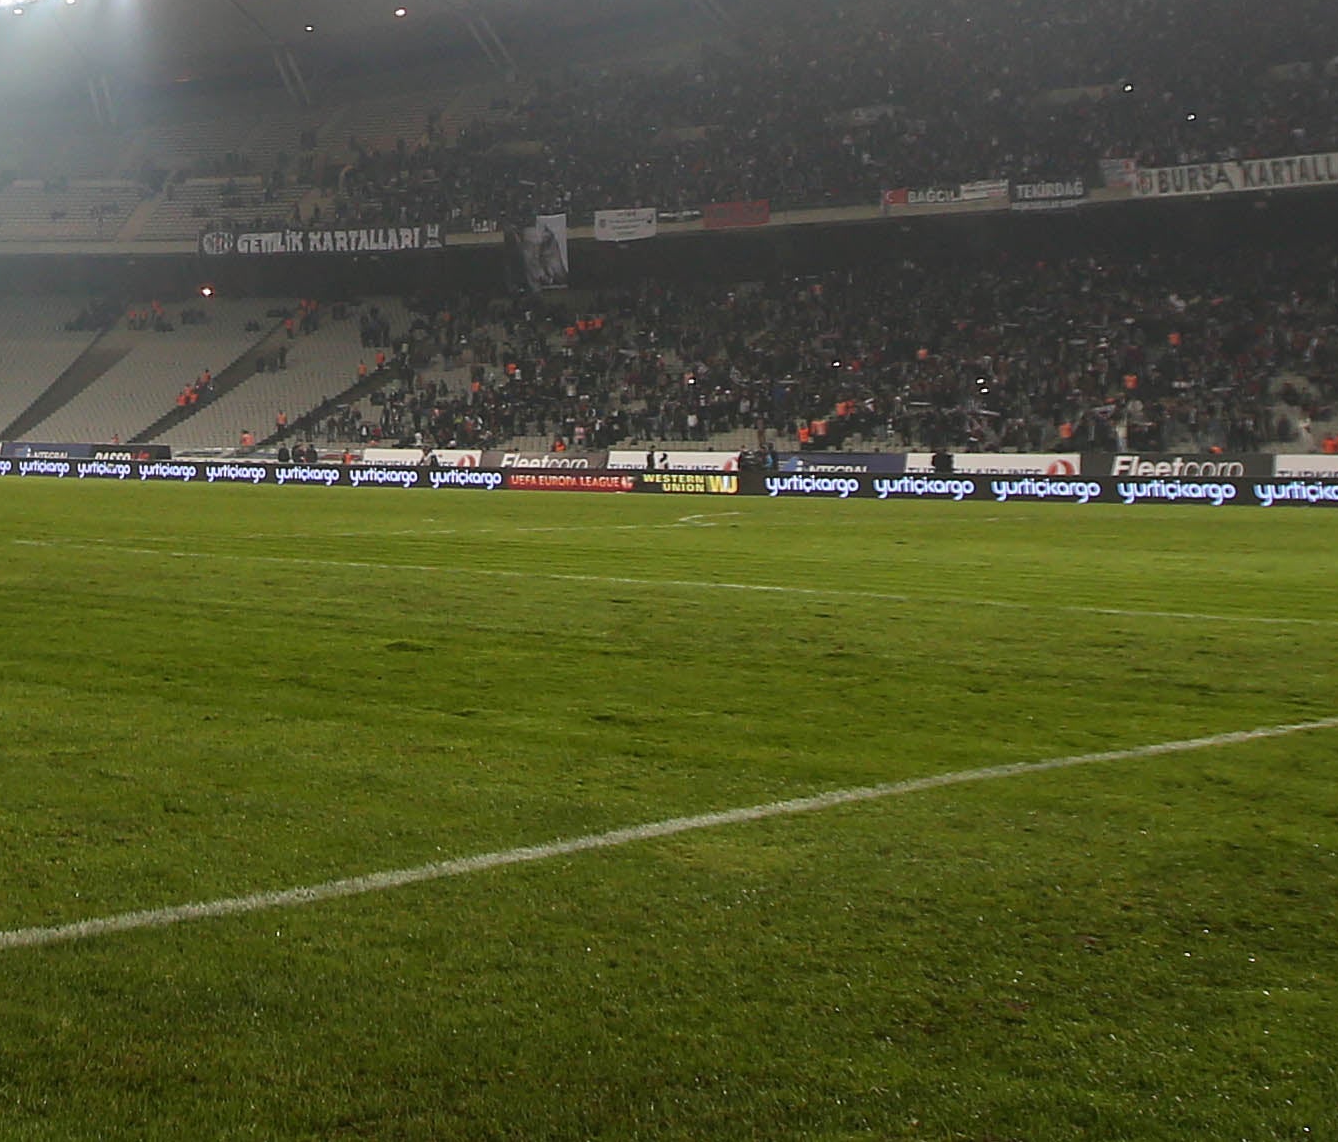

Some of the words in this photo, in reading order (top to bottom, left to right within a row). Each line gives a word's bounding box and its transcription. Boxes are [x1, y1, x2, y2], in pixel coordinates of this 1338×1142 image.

[1158, 164, 1235, 195] BURSA
[907, 187, 964, 204] BAĞCIL
[308, 228, 420, 252] KARTALLARI
[511, 474, 536, 486] UEFA
[538, 475, 578, 488] EUROPA
[580, 476, 620, 489] LEAGUE
[643, 474, 704, 484] WESTERN
[662, 483, 705, 493] UNION
